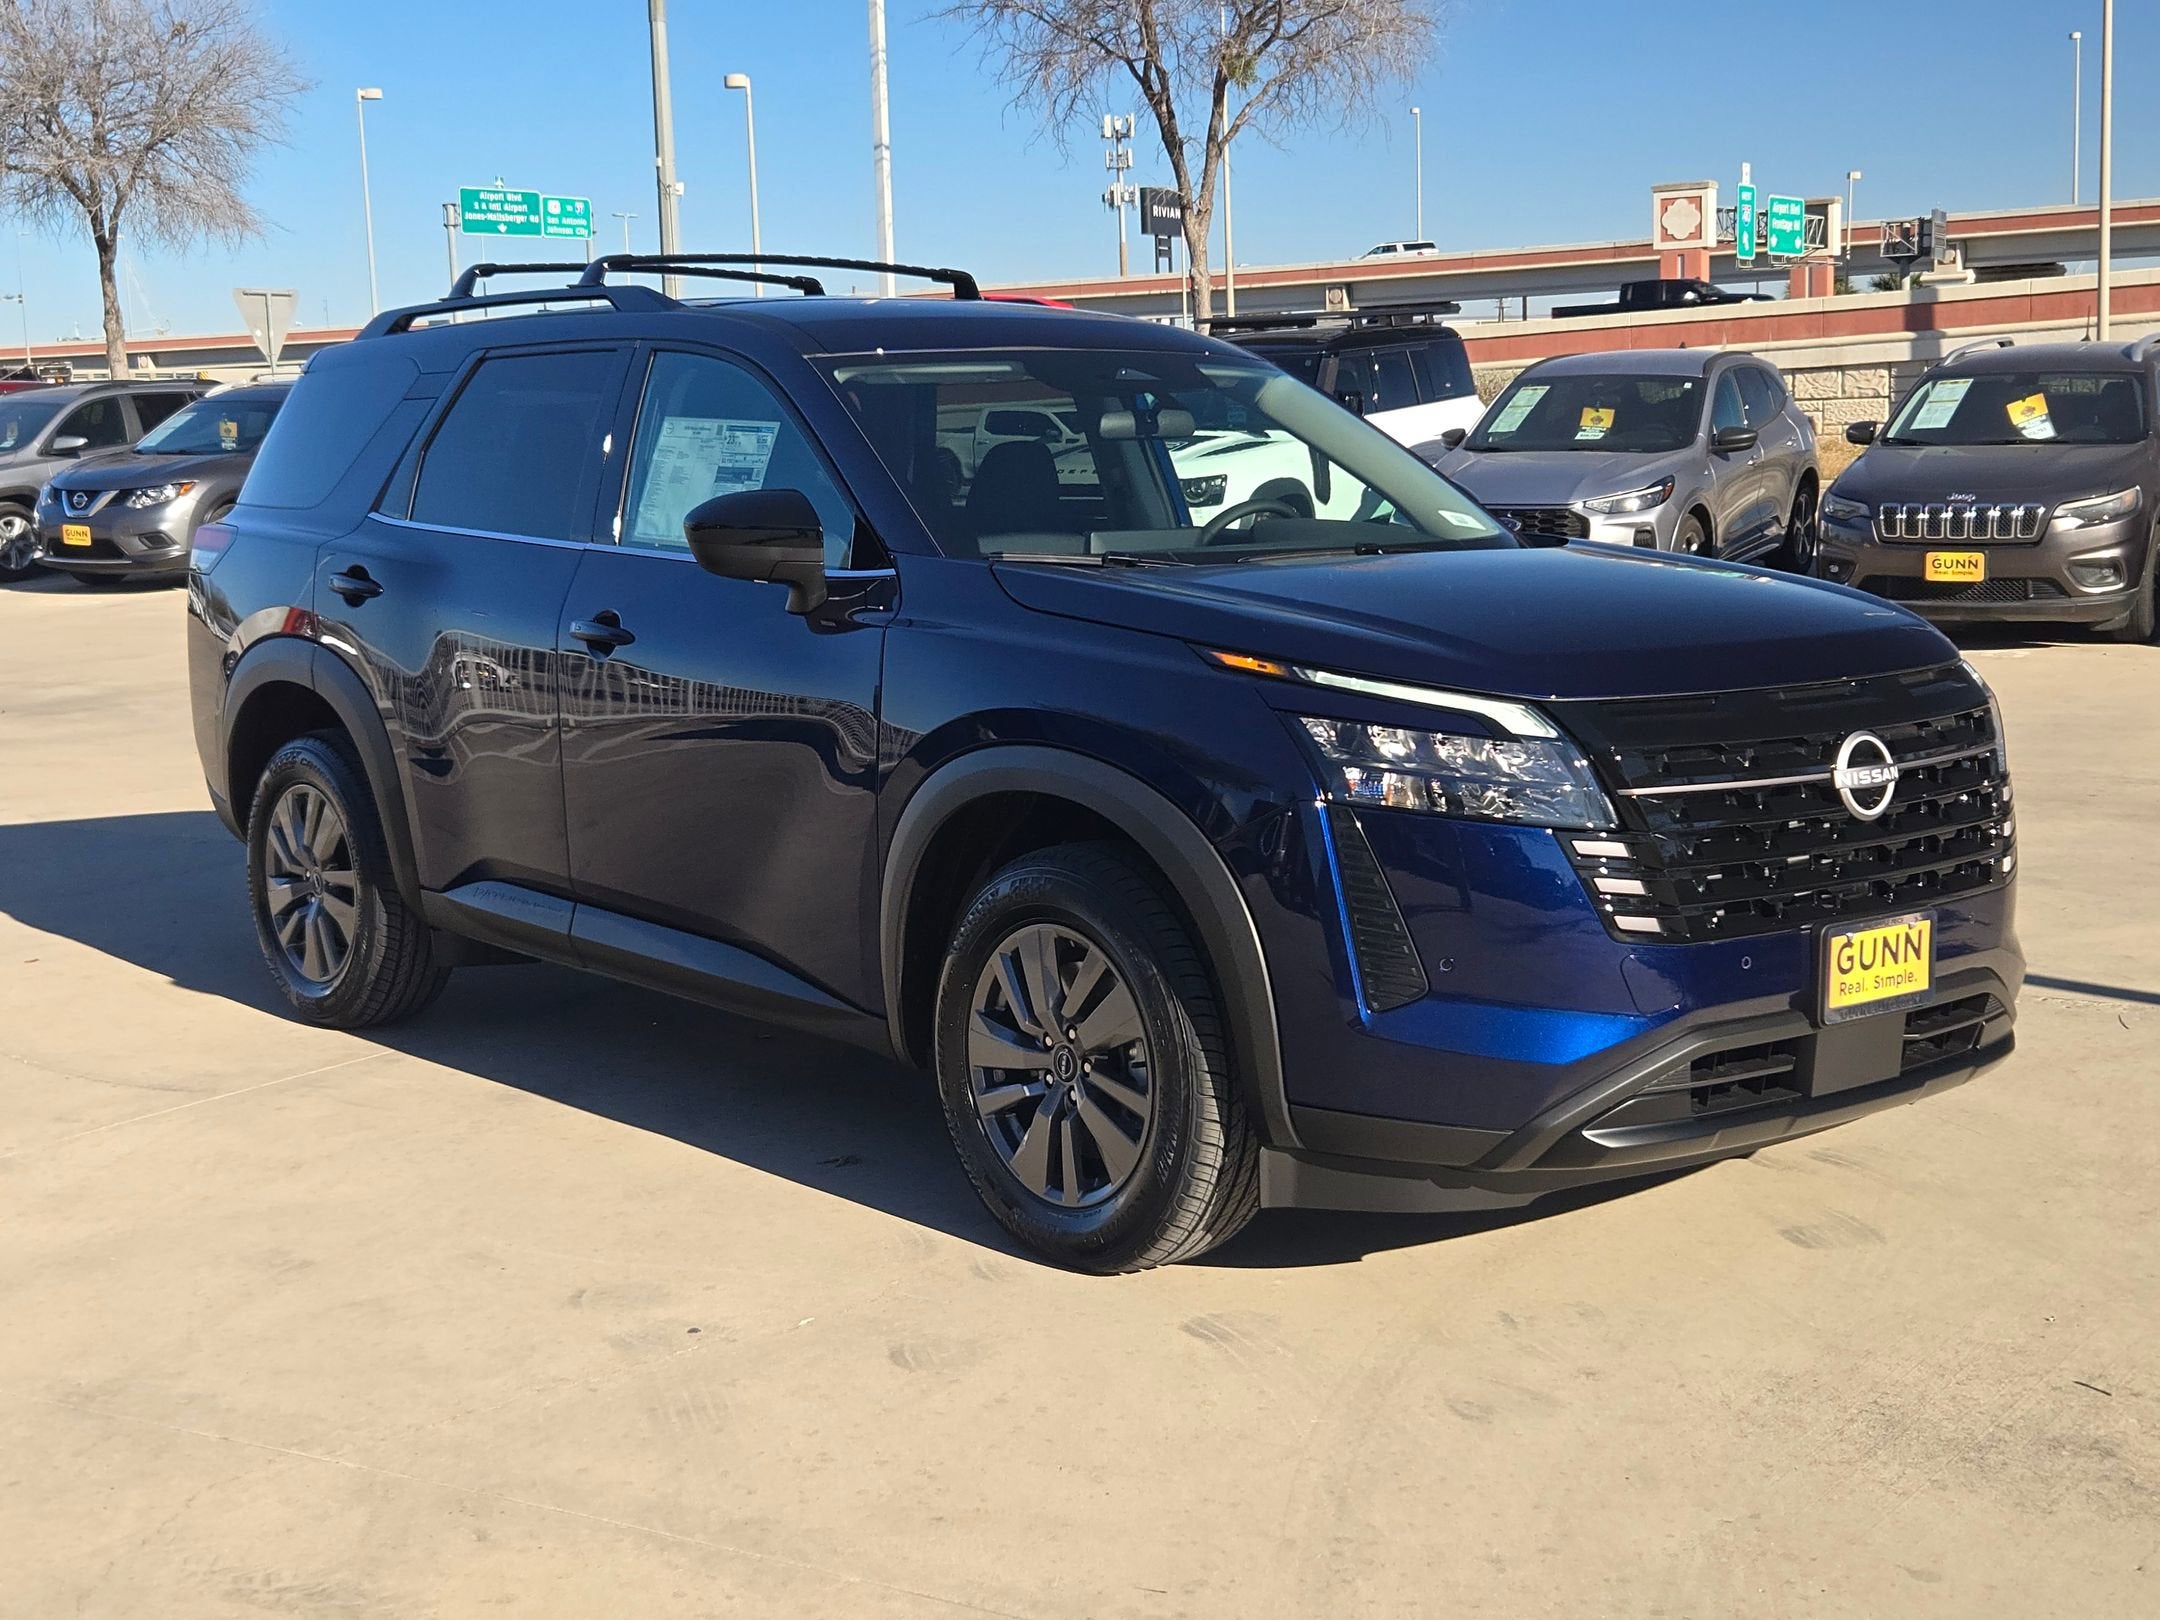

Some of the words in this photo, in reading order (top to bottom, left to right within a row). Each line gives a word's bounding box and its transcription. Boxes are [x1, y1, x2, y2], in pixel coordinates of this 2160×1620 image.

[480, 192, 504, 202] Airport
[507, 192, 522, 201] Blvd
[504, 203, 528, 213] Airport
[1152, 205, 1181, 219] RIVIAN
[1773, 202, 1789, 215] Airport
[530, 215, 539, 223] Rd
[561, 216, 587, 227] Antonio
[576, 226, 588, 237] City
[65, 528, 88, 538] GUNN
[1932, 558, 1978, 570] GUNN
[1837, 765, 1899, 786] NISSAN
[1837, 929, 1923, 976] GUNN
[1840, 977, 1869, 996] Real.
[1874, 969, 1918, 990] Simple.
